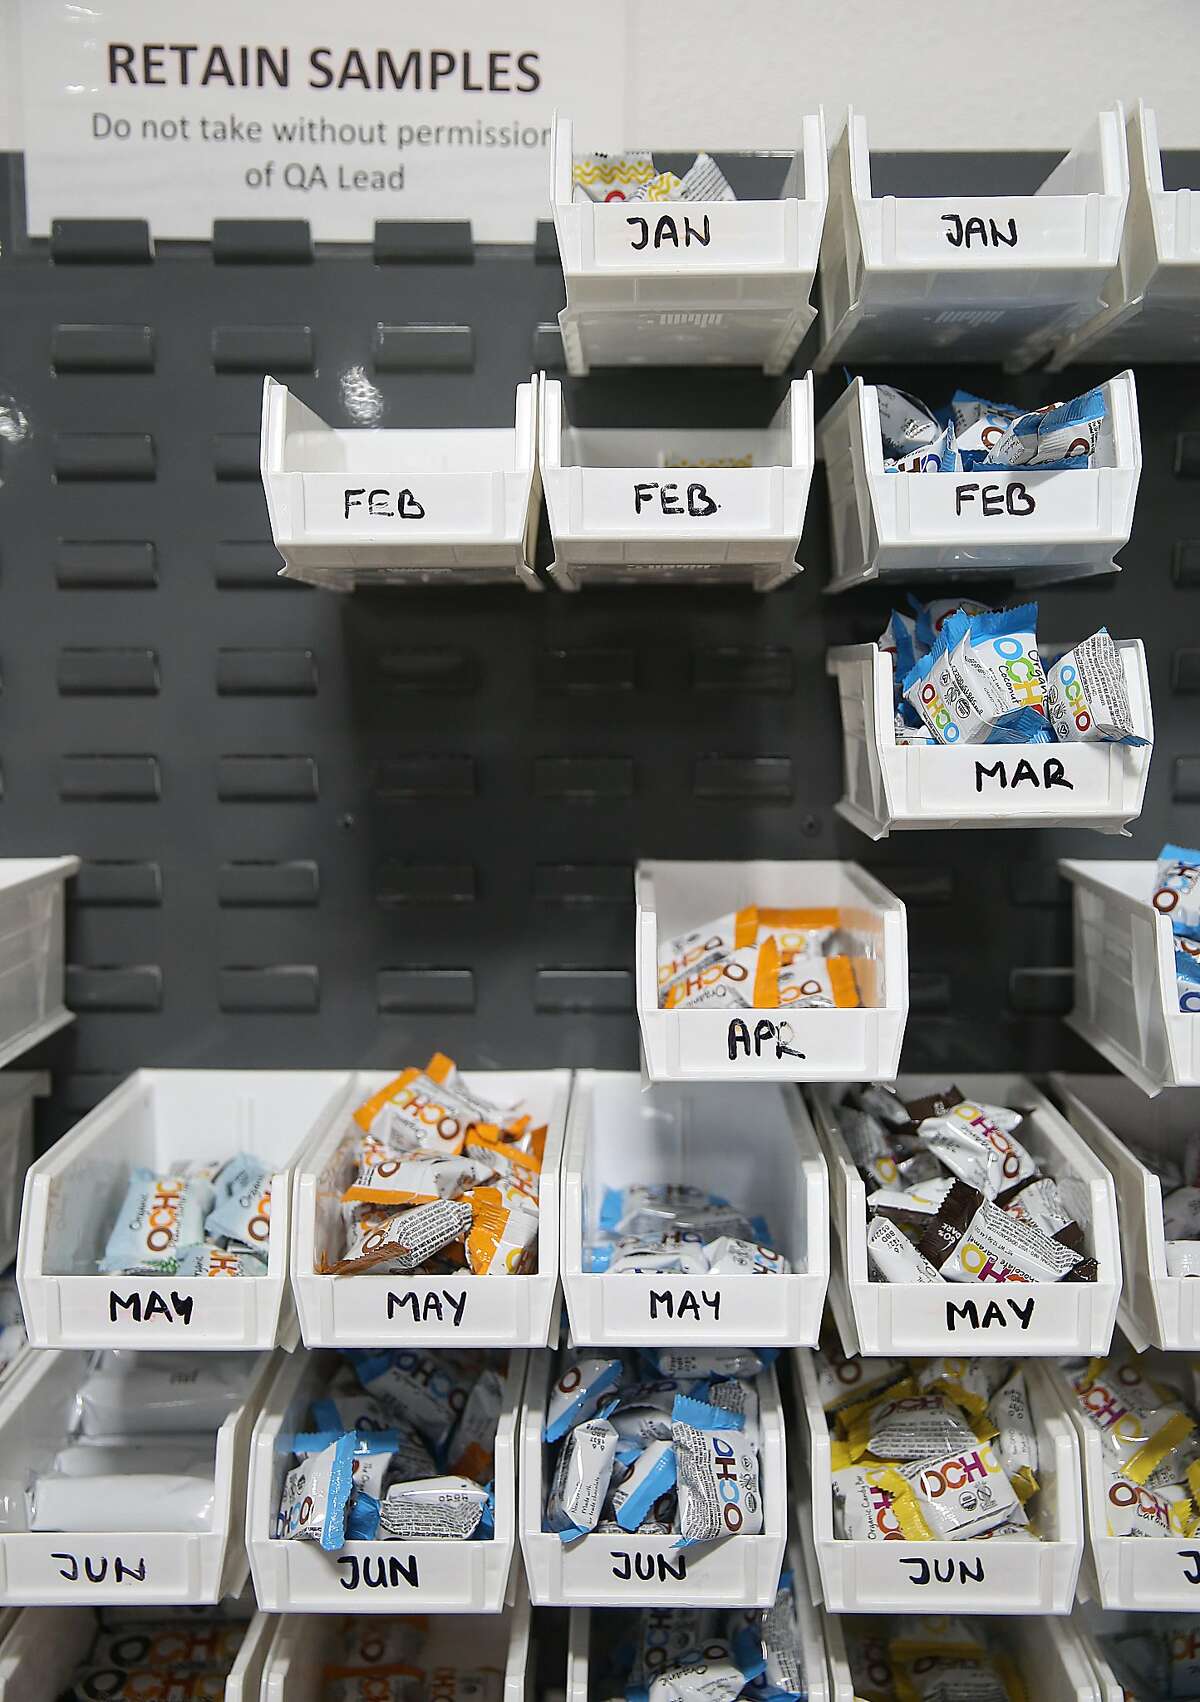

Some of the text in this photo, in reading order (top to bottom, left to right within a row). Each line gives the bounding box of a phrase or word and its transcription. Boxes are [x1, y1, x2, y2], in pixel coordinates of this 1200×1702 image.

[109, 44, 540, 92] RETAIN SAMPLES
[92, 113, 131, 140] Do
[142, 117, 189, 141] not
[200, 115, 262, 142] take
[273, 118, 386, 144] without
[245, 161, 404, 192] of QA Lead
[627, 215, 710, 250] JAN
[941, 214, 1017, 248] JAN
[345, 489, 425, 519] FEB
[956, 483, 1035, 516] FEB
[998, 664, 1021, 704] Coconut
[1059, 665, 1092, 732] OCHO
[921, 683, 960, 743] OCHO
[975, 758, 1073, 792] MAR
[727, 1017, 806, 1060] APR
[390, 1088, 461, 1140] OCHO
[955, 1105, 1022, 1178] OCHO
[941, 1223, 961, 1239] DARK
[967, 1235, 999, 1264] Caramel
[110, 1291, 193, 1325] MAY
[388, 1290, 466, 1326] MAY
[650, 1291, 720, 1320] MAY
[947, 1298, 1034, 1330] MAY
[712, 1437, 743, 1532] OCHO
[919, 1446, 1001, 1498] OCHO
[51, 1554, 145, 1582] JUN
[337, 1554, 419, 1589] JUN
[610, 1551, 687, 1582] JUN
[899, 1557, 984, 1584] JUN
